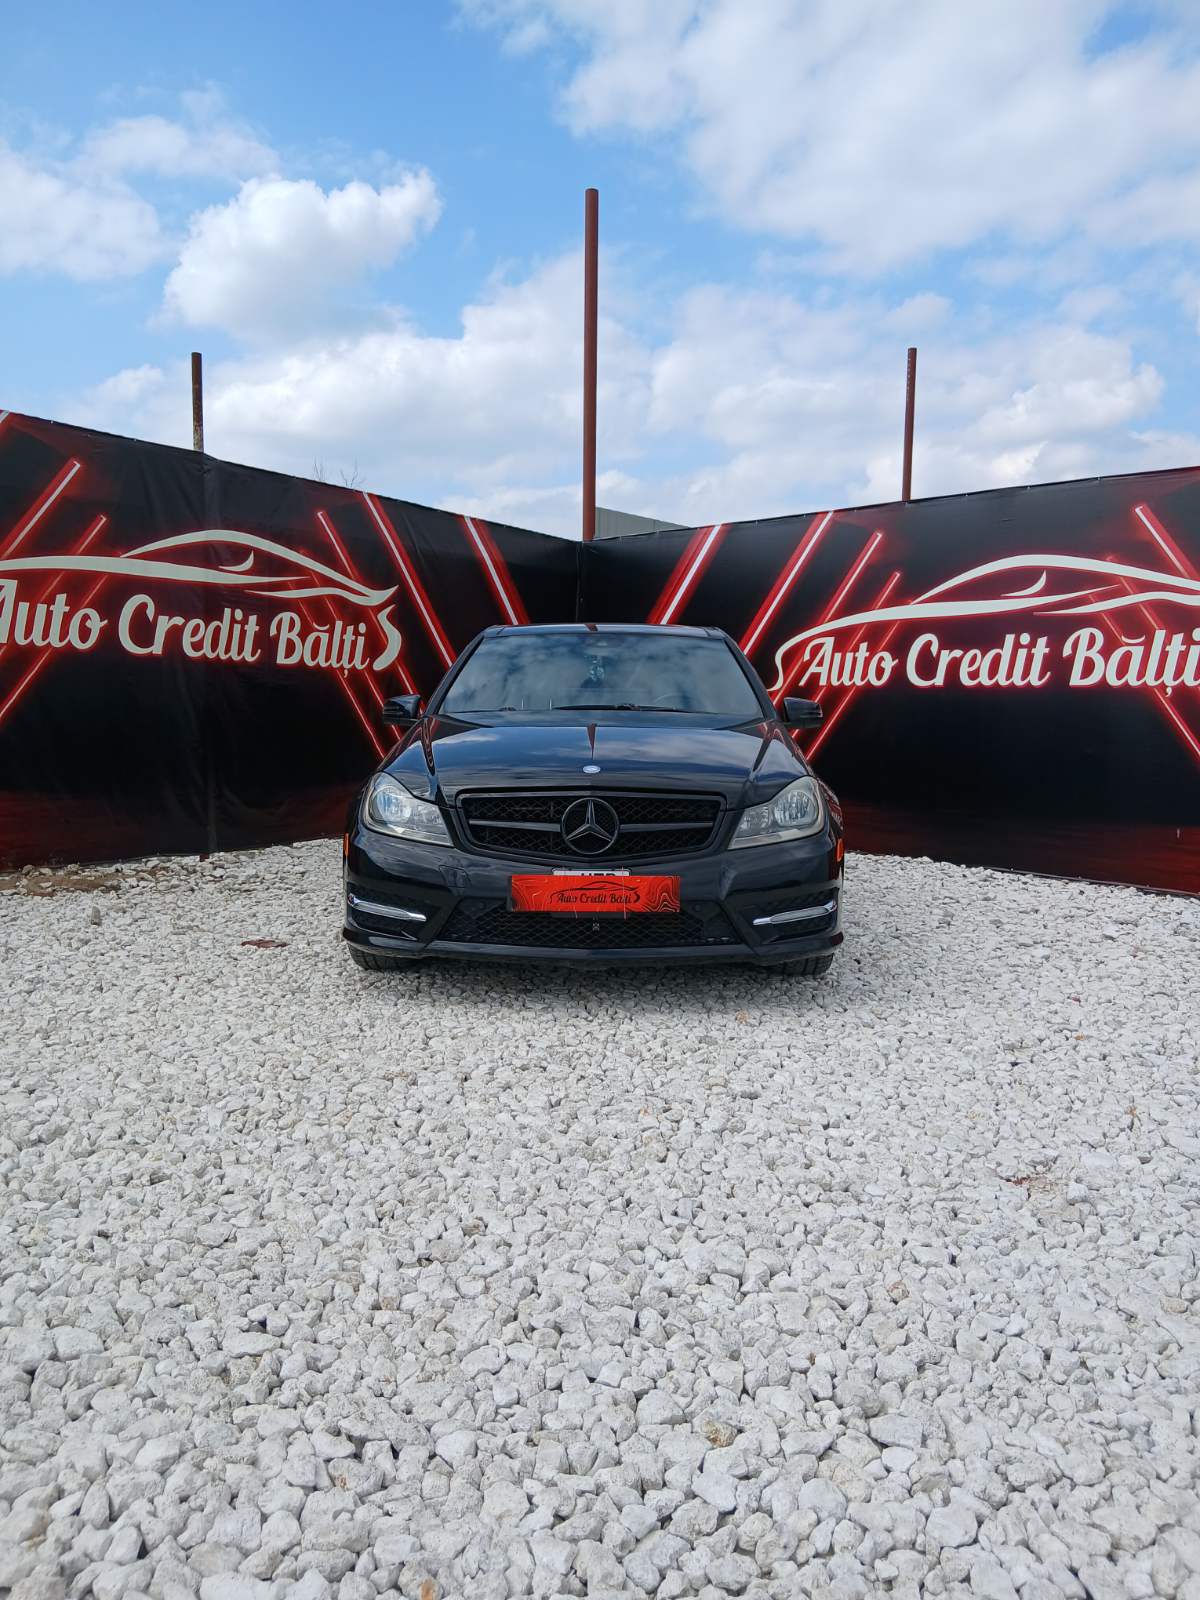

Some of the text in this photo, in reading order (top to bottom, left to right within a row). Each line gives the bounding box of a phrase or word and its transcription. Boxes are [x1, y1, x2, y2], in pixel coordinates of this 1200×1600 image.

[118, 594, 261, 662] Credit
[270, 612, 369, 678] Bălți
[798, 637, 898, 687] Auto
[906, 633, 1051, 687] Credit
